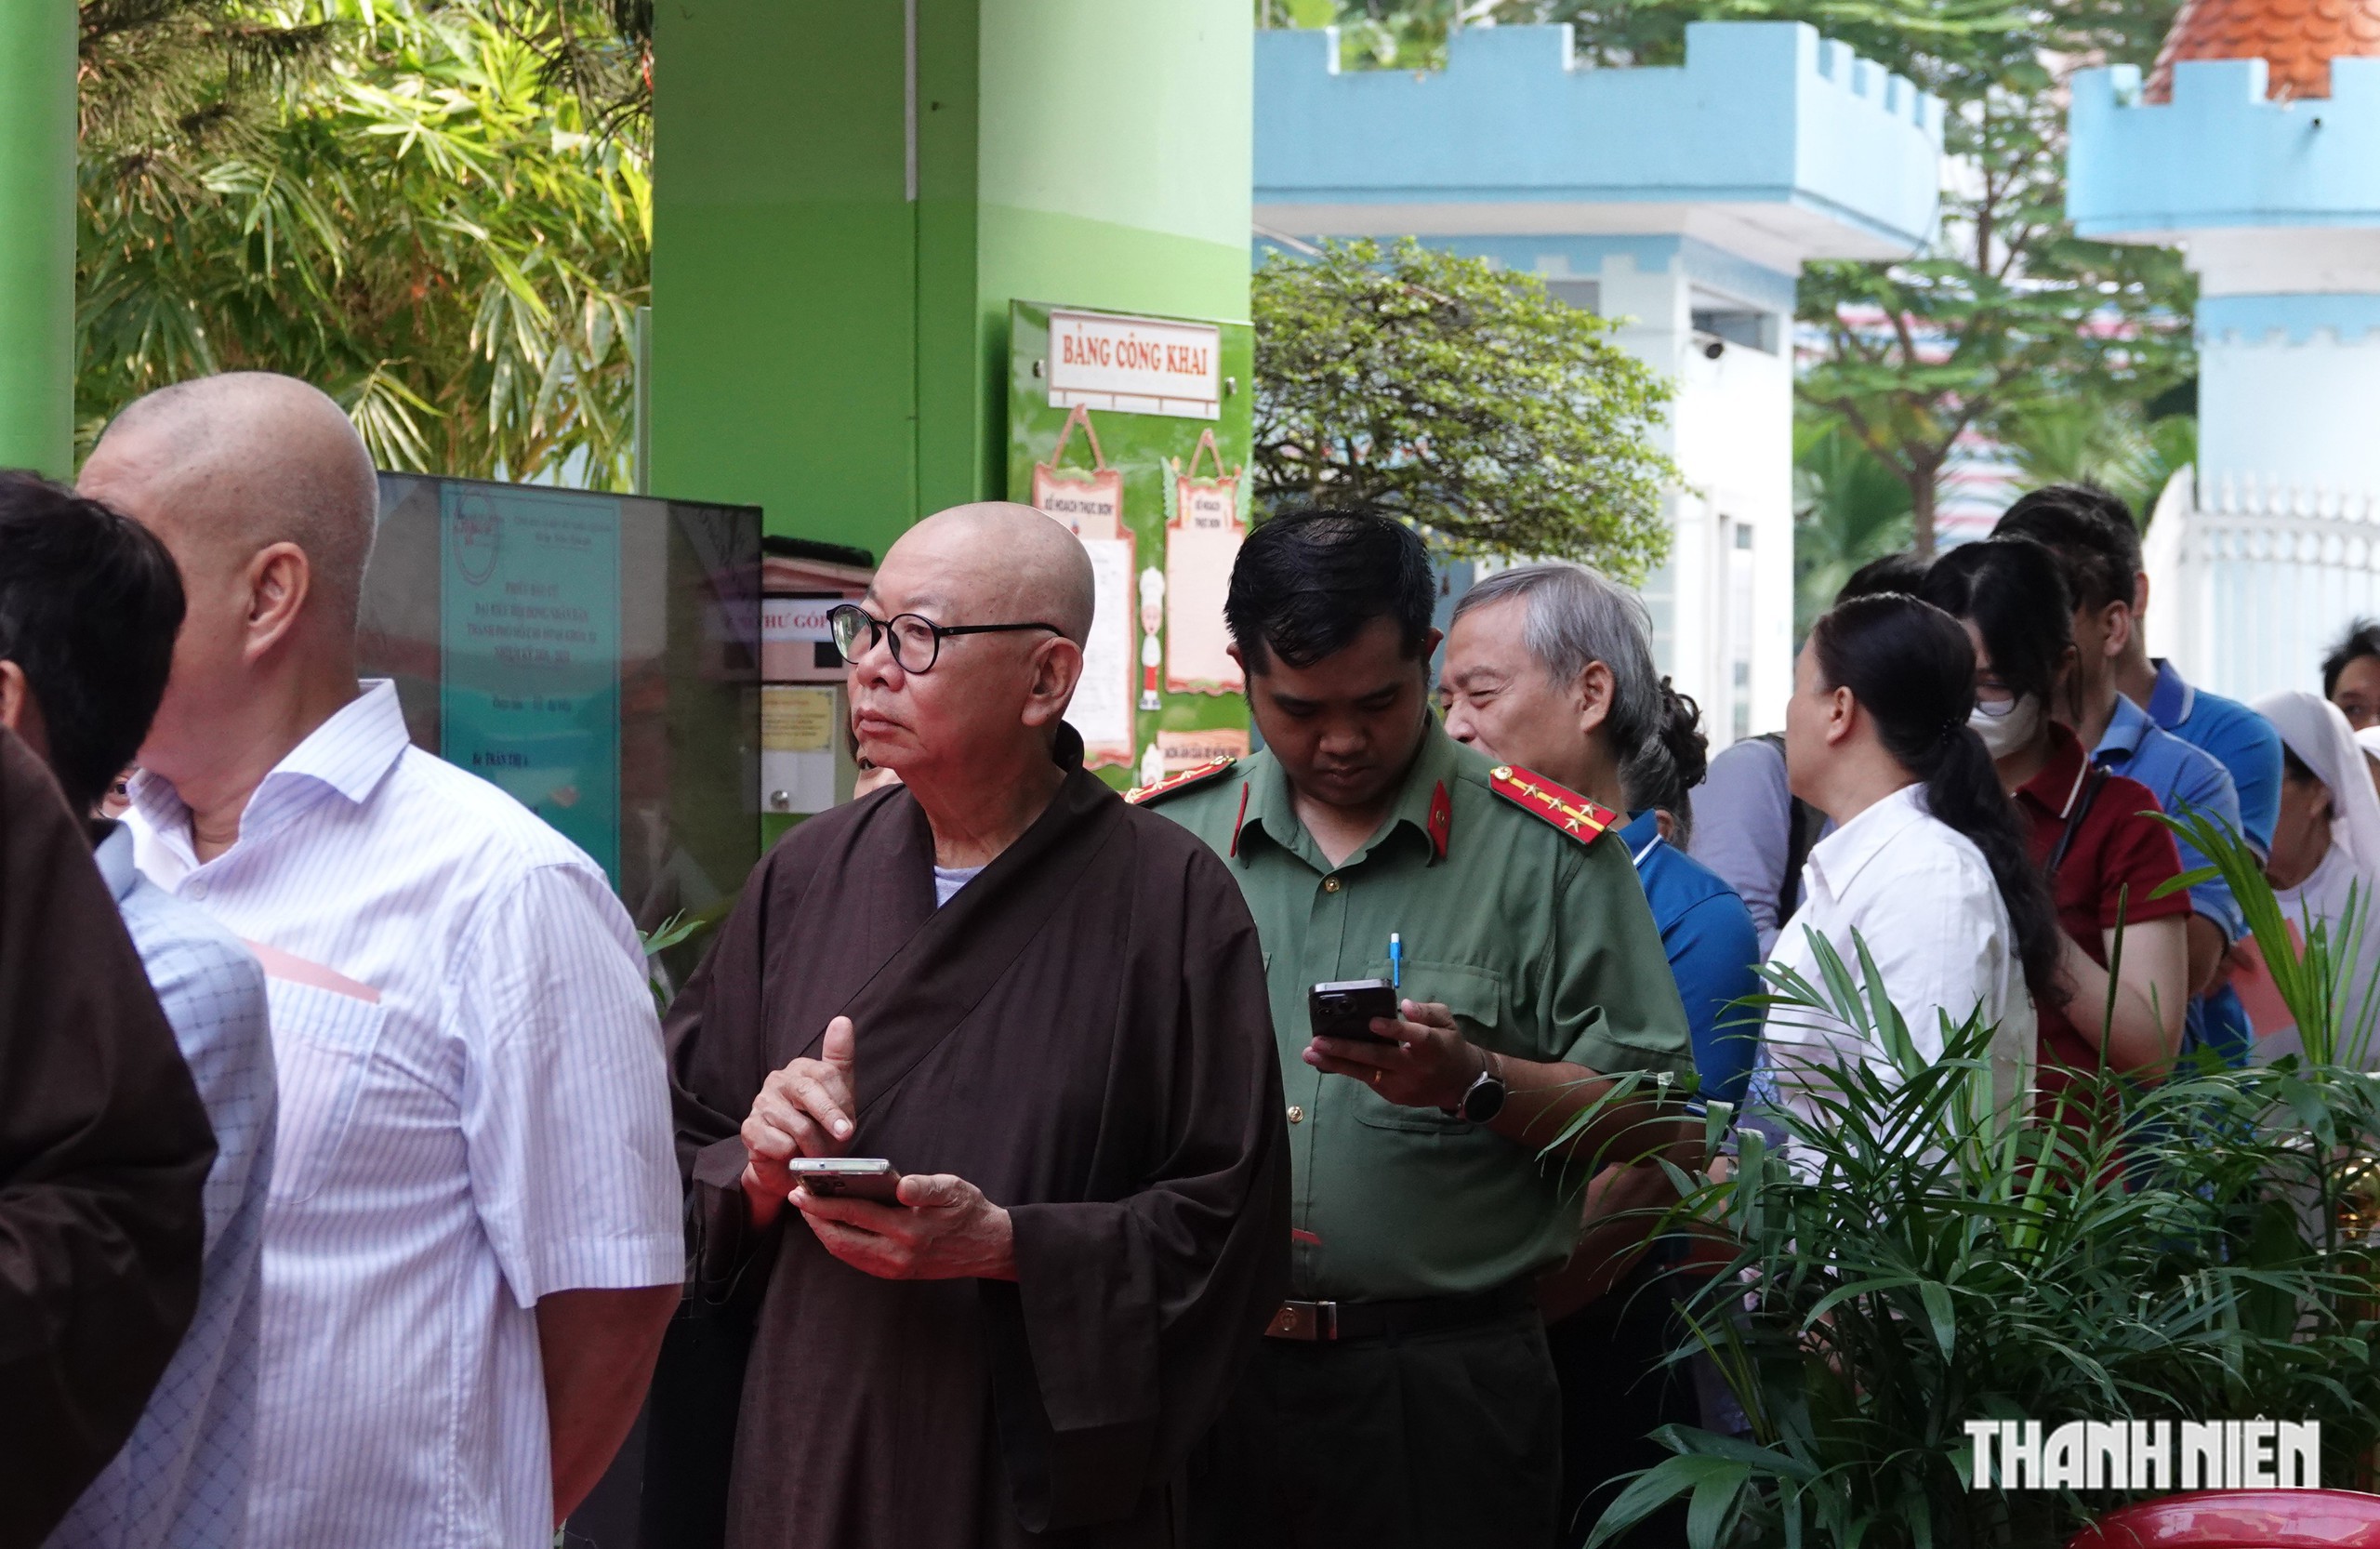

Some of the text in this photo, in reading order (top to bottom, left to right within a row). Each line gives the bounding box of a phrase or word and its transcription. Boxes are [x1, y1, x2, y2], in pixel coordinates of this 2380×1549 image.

[1063, 323, 1208, 376] BẢNG CÔNG KHAI
[764, 612, 791, 629] HƯ
